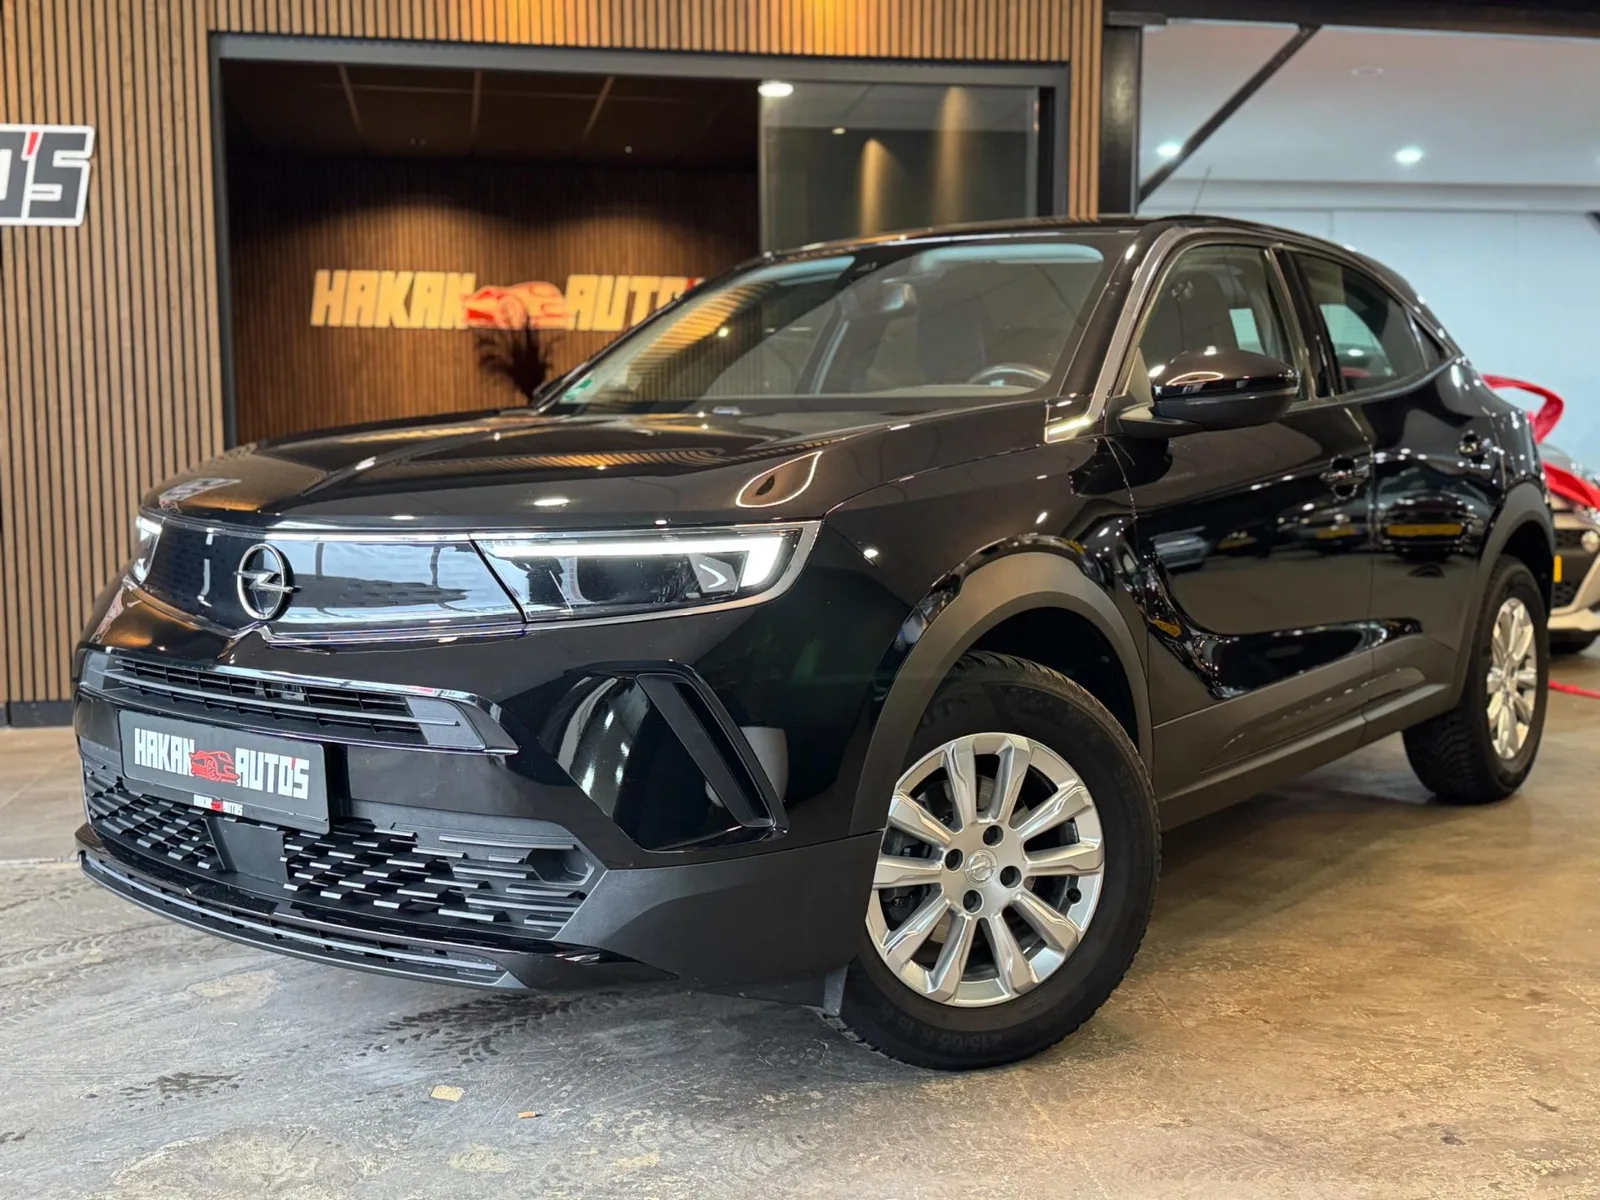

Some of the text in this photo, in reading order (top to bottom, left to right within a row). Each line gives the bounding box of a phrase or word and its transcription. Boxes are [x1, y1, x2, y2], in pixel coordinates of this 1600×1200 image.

[311, 270, 476, 329] HAKAN
[134, 727, 310, 800] HAKAN AUTO'S
